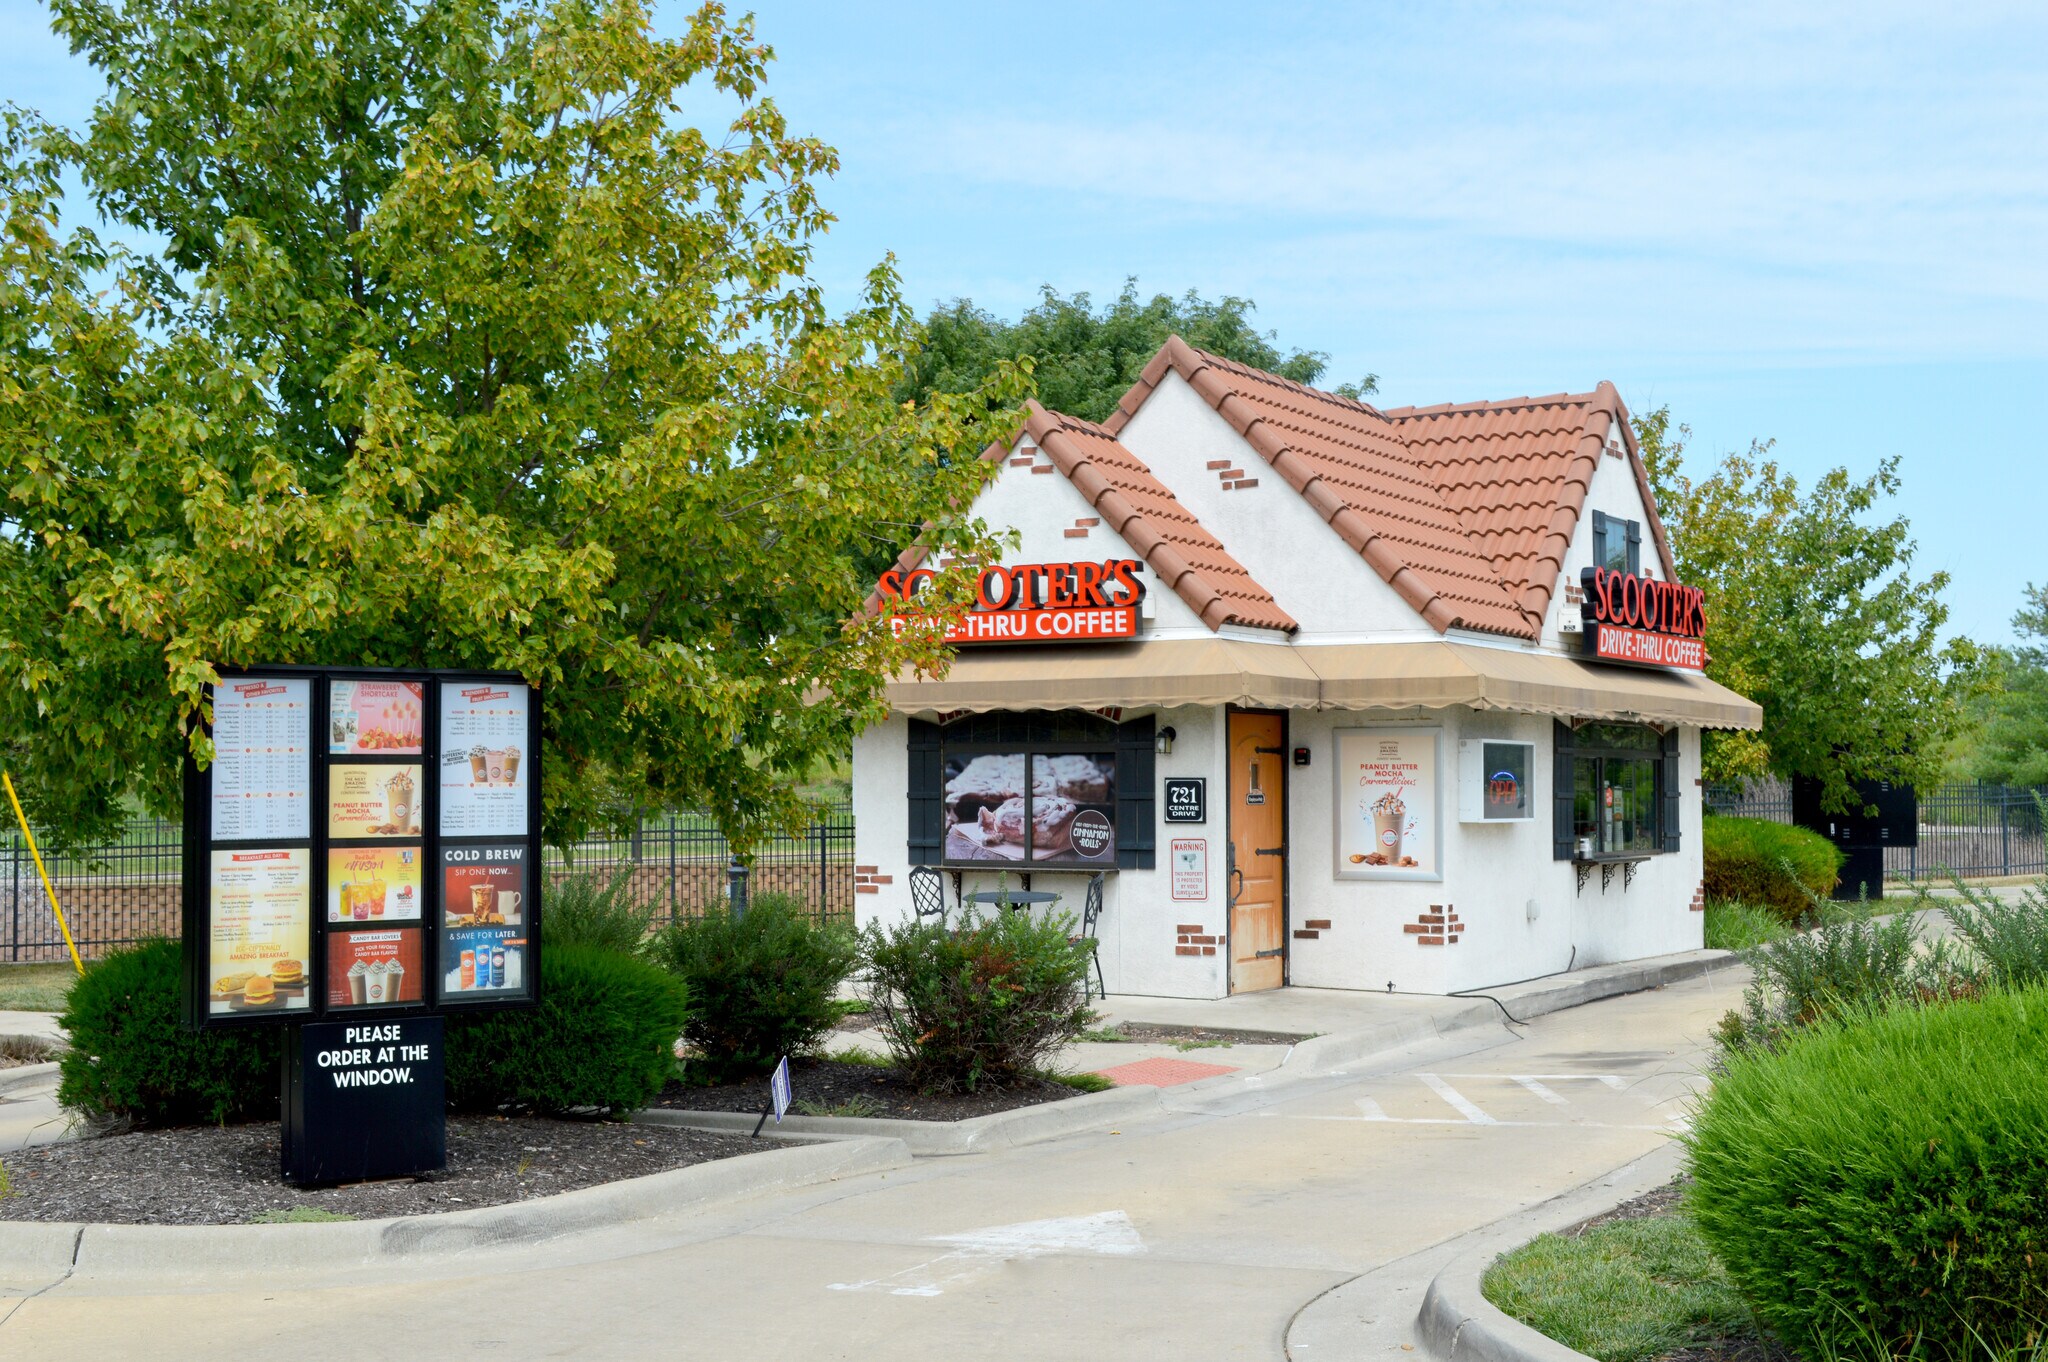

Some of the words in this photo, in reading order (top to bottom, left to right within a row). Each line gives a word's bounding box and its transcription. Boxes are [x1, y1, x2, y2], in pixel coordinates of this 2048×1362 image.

[878, 559, 1140, 612] SCOTER'S
[1595, 566, 1706, 638] SCOOTER'S
[1035, 610, 1127, 636] COFFEE
[1600, 627, 1663, 662] DRIVE-THRU
[1665, 638, 1702, 667] COFFEE
[361, 683, 401, 691] STRAWBERRY
[361, 690, 399, 698] SHORTCAKE
[1170, 786, 1198, 804] 721
[1490, 780, 1517, 805] OPEN
[1073, 827, 1110, 841] CINNAMON
[445, 850, 480, 861] COLD
[485, 849, 522, 860] BREW
[1174, 843, 1204, 852] WARNING
[455, 868, 466, 876] SIP
[469, 868, 486, 876] ONE
[449, 933, 455, 941] &
[456, 932, 475, 940] SAVE
[477, 931, 493, 939] FOR
[495, 930, 517, 939] LATER.
[259, 951, 289, 959] BREAKFAST
[346, 1025, 401, 1044] PLEASE
[317, 1049, 372, 1067] ORDER
[376, 1046, 396, 1063] AT
[400, 1044, 429, 1062] THE
[333, 1067, 414, 1089] WINDOW.
